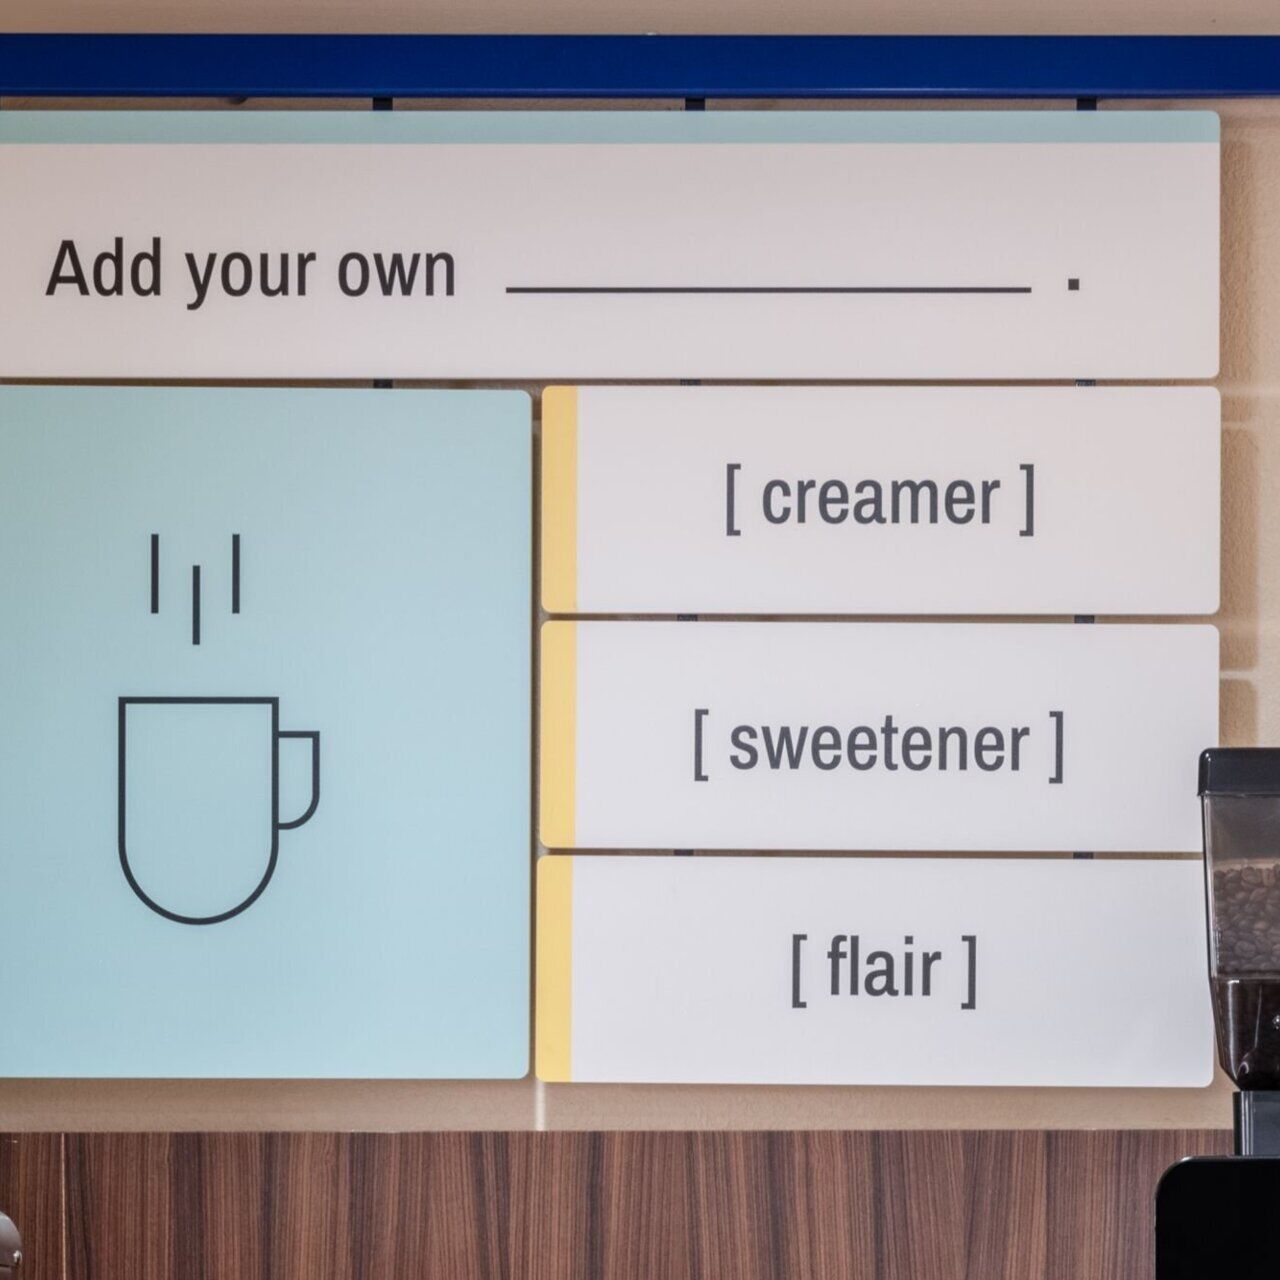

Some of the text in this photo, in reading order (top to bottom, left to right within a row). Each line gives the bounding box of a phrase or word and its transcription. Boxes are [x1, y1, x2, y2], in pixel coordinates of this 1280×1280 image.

[44, 236, 455, 311] Add your own
[762, 478, 1001, 525] creamer
[729, 714, 1030, 773] sweetener
[827, 934, 942, 997] flair
